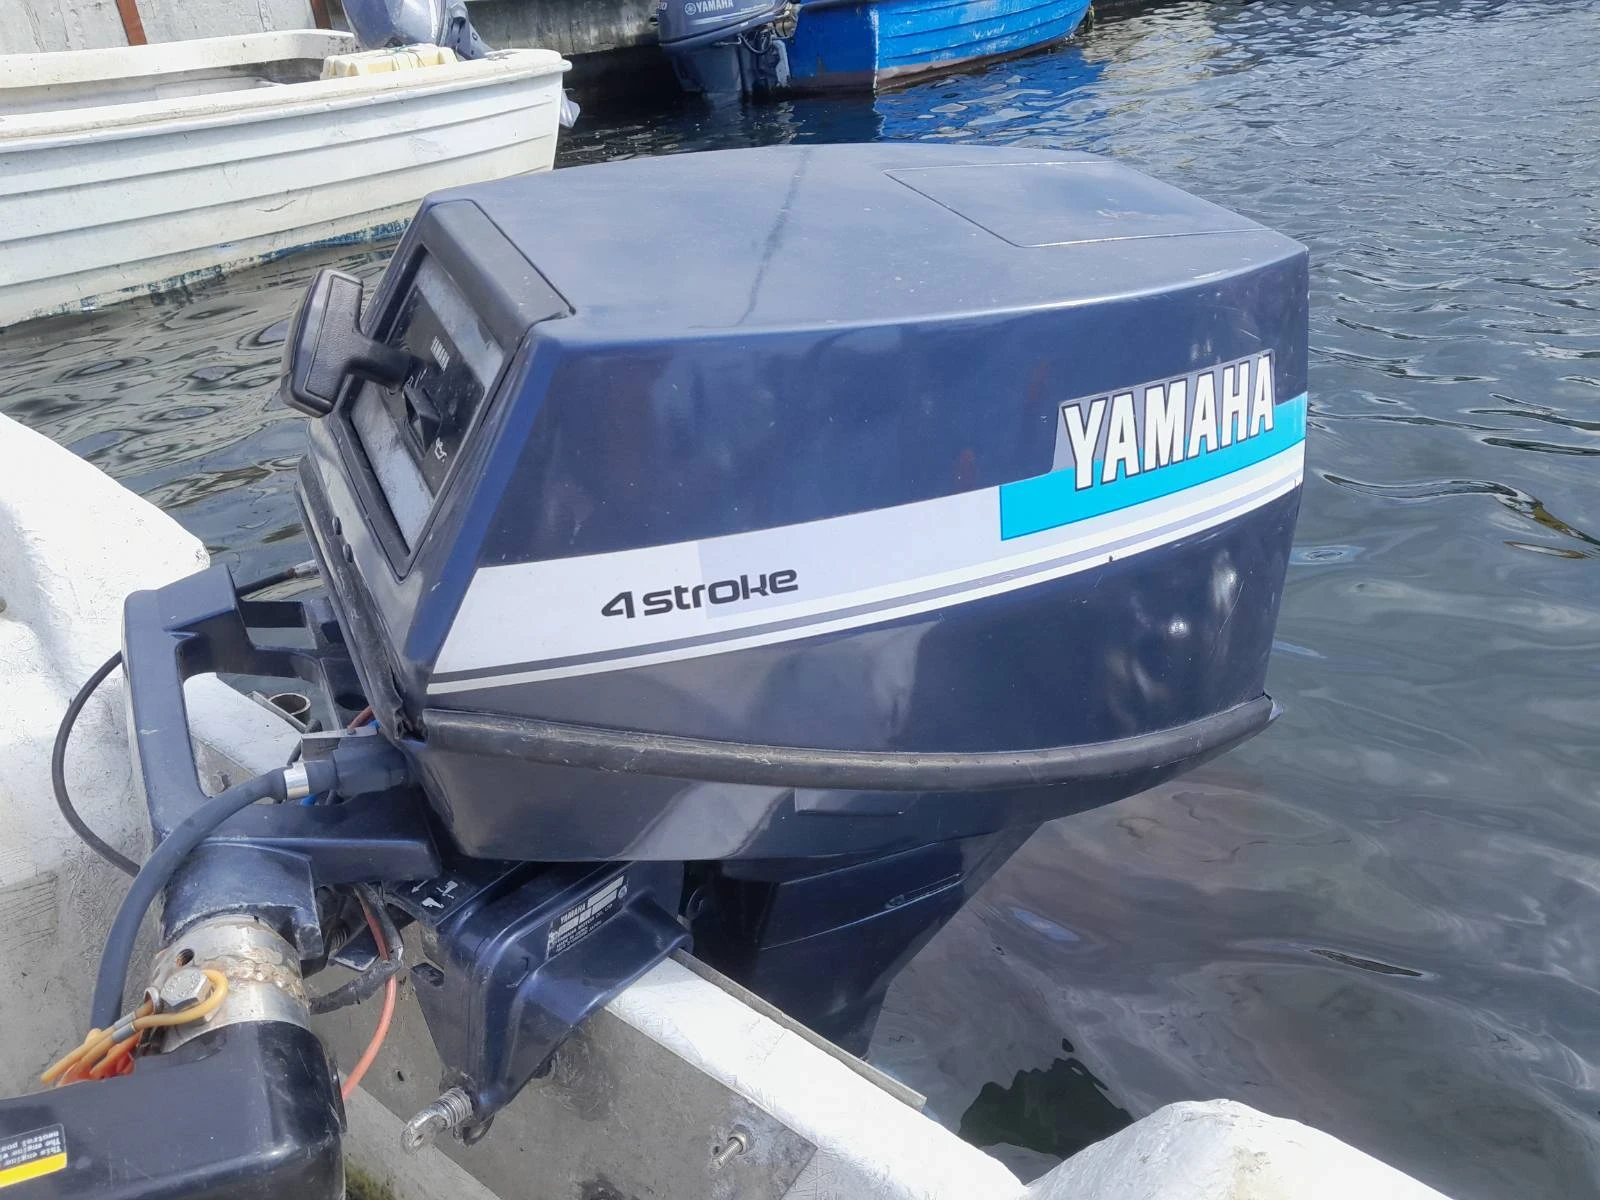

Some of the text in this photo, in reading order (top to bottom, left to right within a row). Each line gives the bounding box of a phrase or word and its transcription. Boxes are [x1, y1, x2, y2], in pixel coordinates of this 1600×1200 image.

[696, 0, 734, 13] YAMAHA
[1062, 354, 1275, 491] YAMAHA
[601, 569, 799, 619] 4 stroke
[560, 903, 586, 924] YAMAHA
